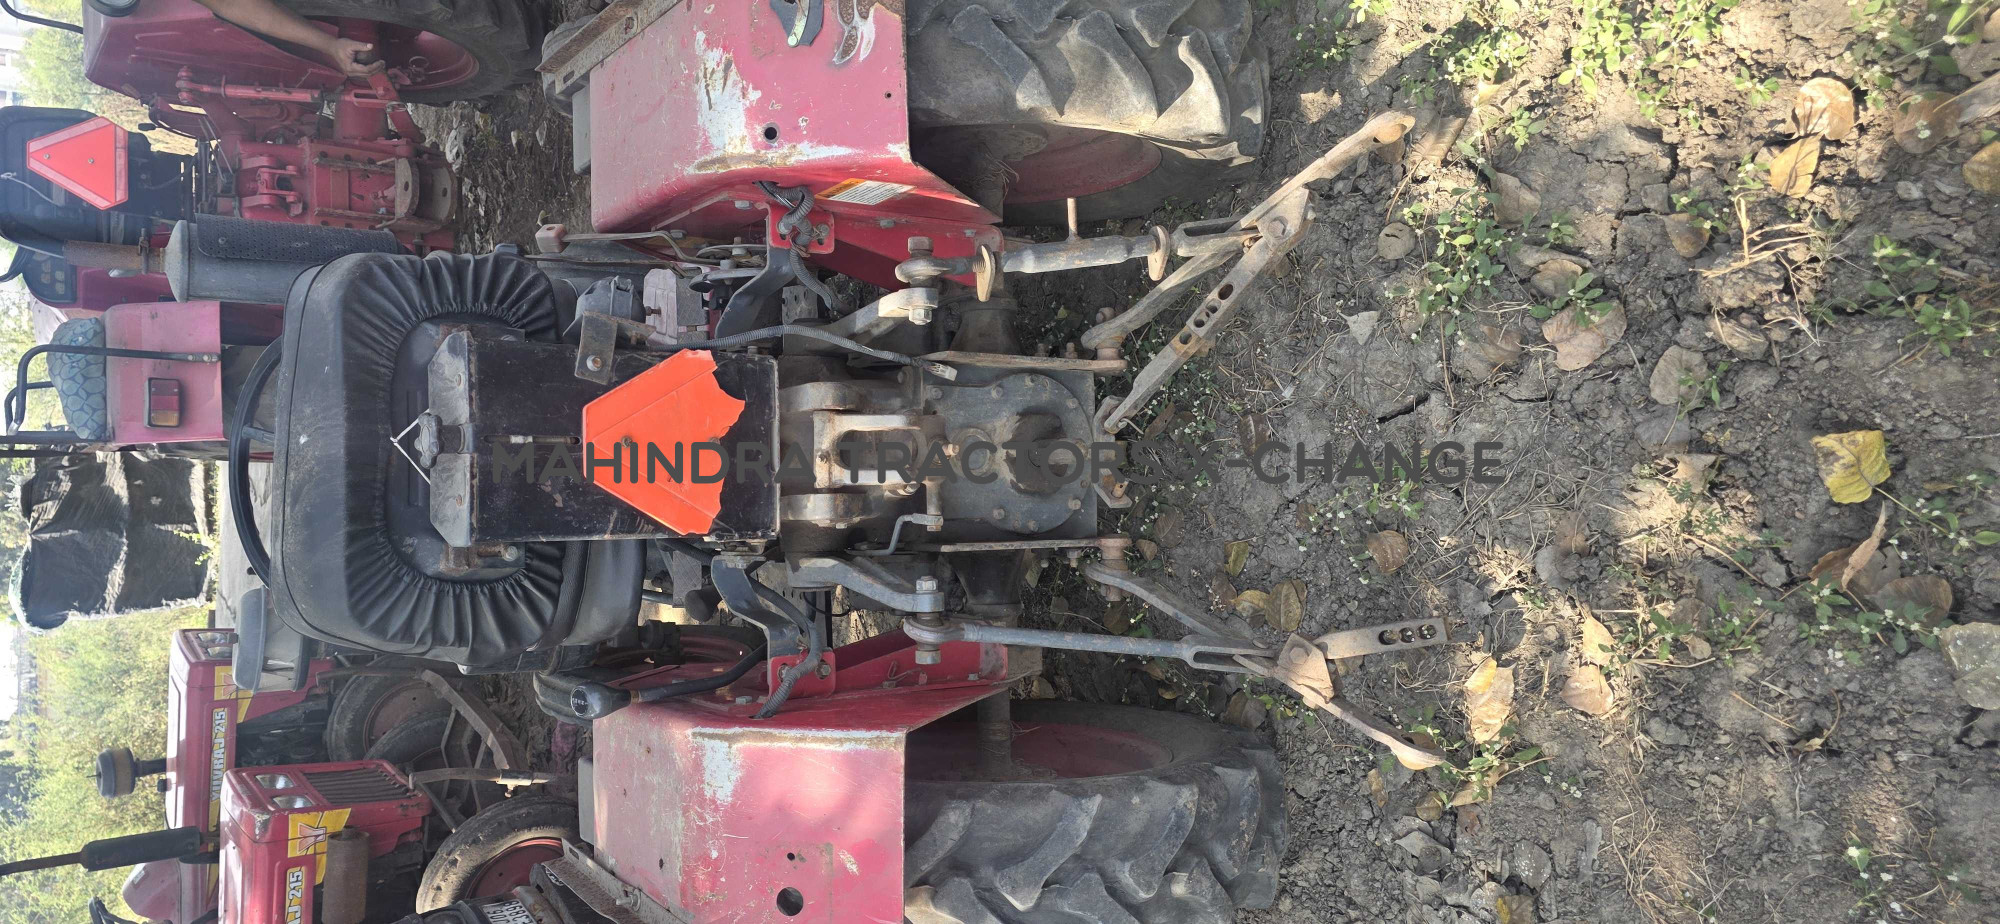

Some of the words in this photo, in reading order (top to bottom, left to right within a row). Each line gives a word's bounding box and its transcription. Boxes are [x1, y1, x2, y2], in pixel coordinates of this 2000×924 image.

[213, 711, 226, 734] 215
[211, 737, 225, 802] YUVRAJ
[287, 871, 304, 900] 215
